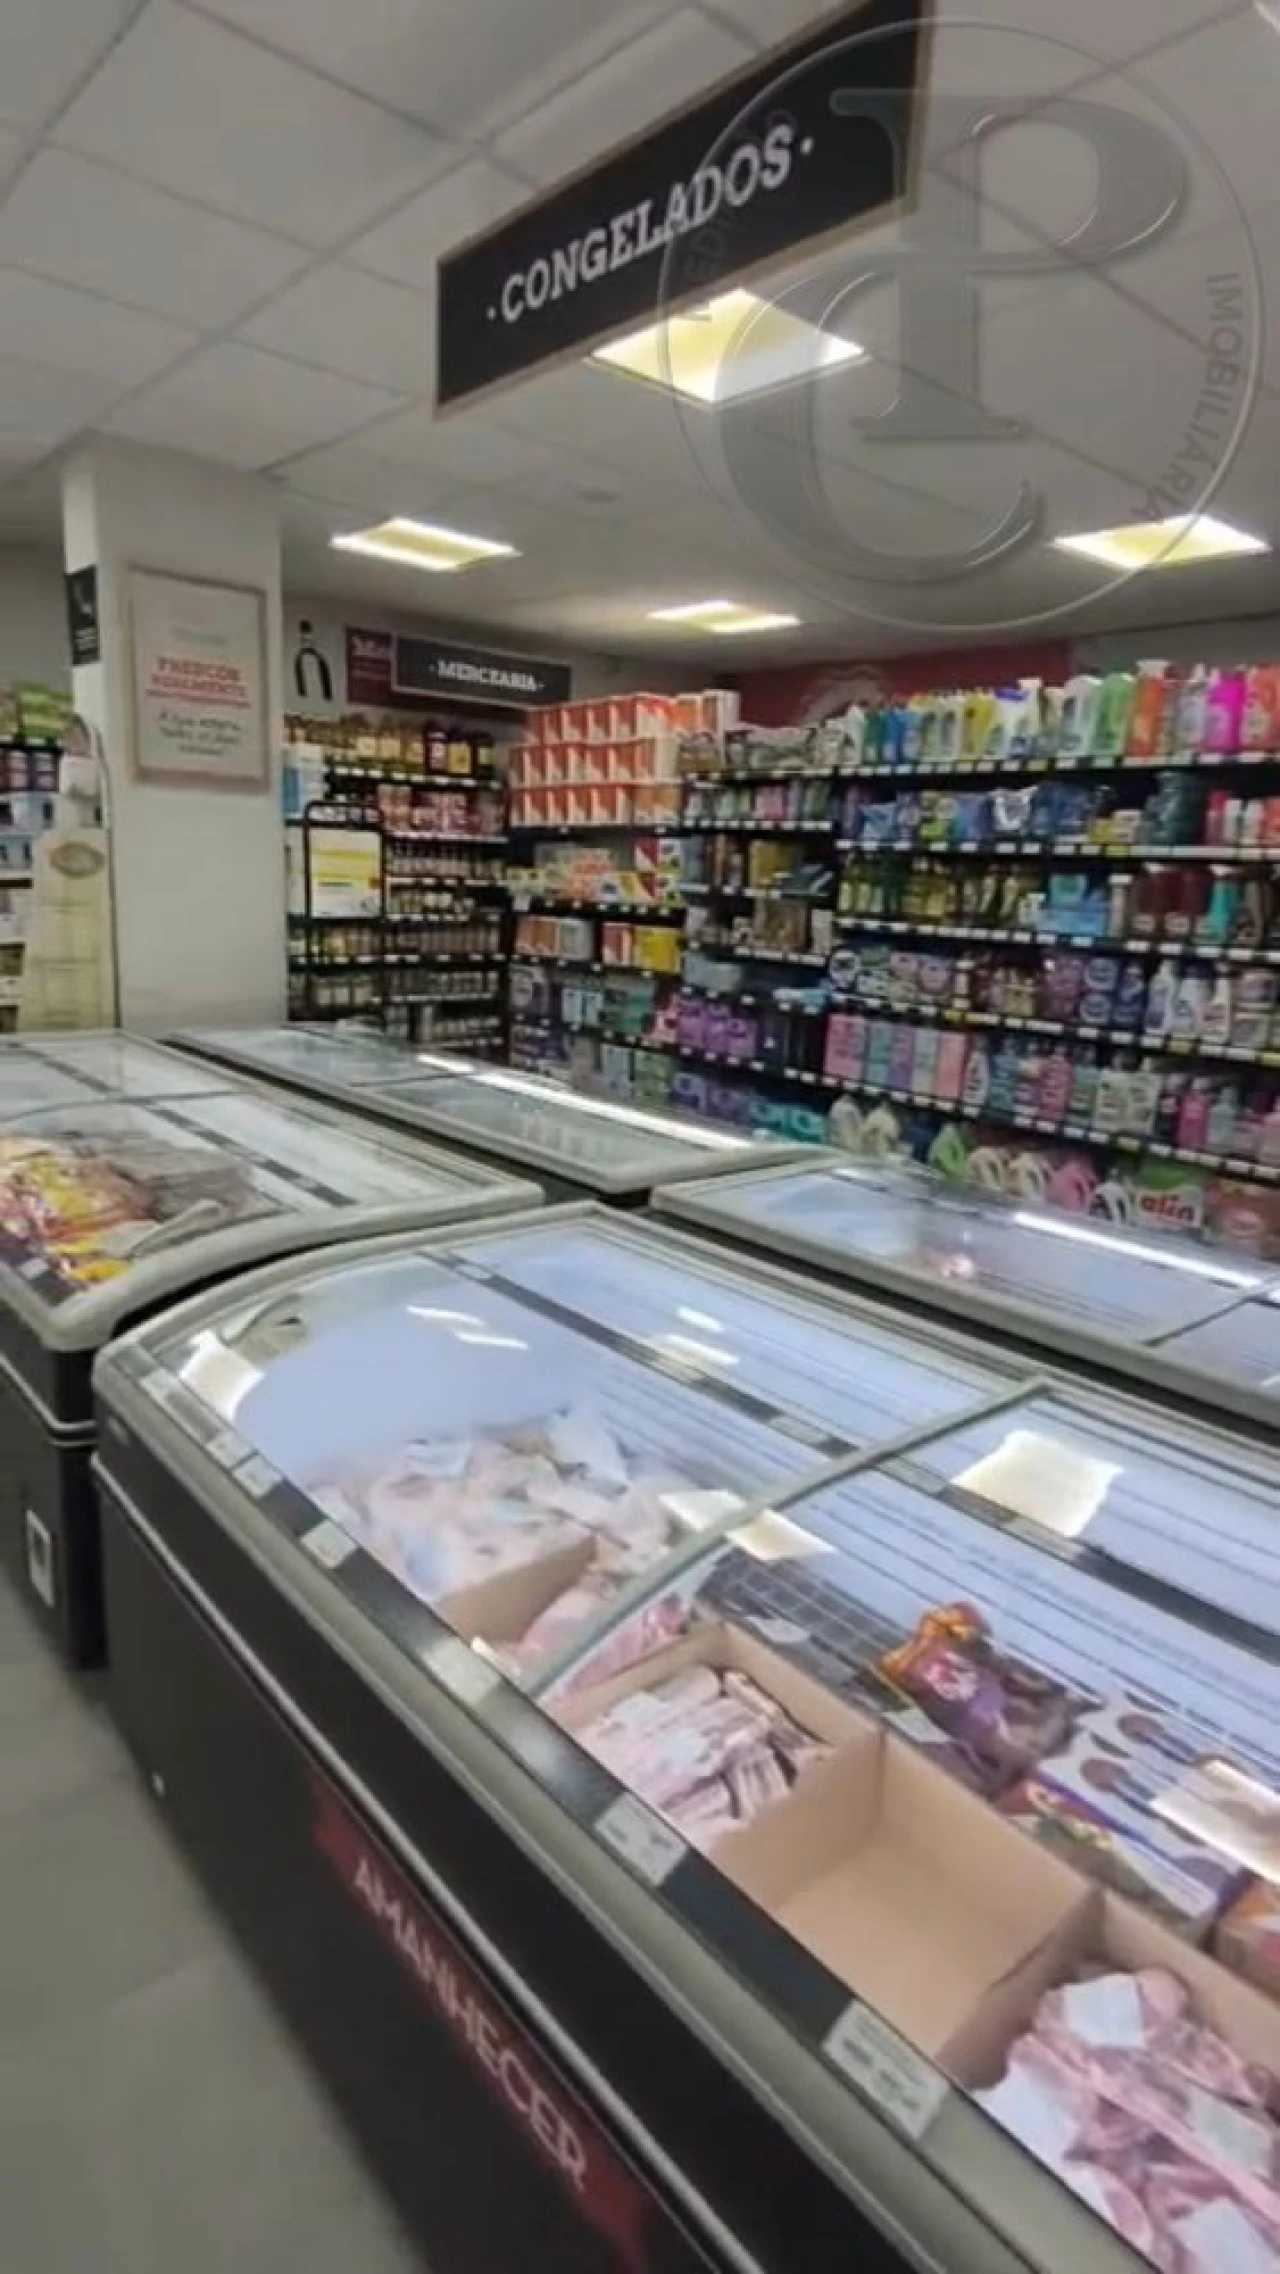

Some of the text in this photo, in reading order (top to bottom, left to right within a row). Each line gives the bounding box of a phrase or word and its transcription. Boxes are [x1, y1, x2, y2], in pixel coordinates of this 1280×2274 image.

[501, 123, 794, 323] CONGELADOS
[437, 659, 538, 692] MERCEARIA
[354, 1859, 589, 2194] AMANHECER
